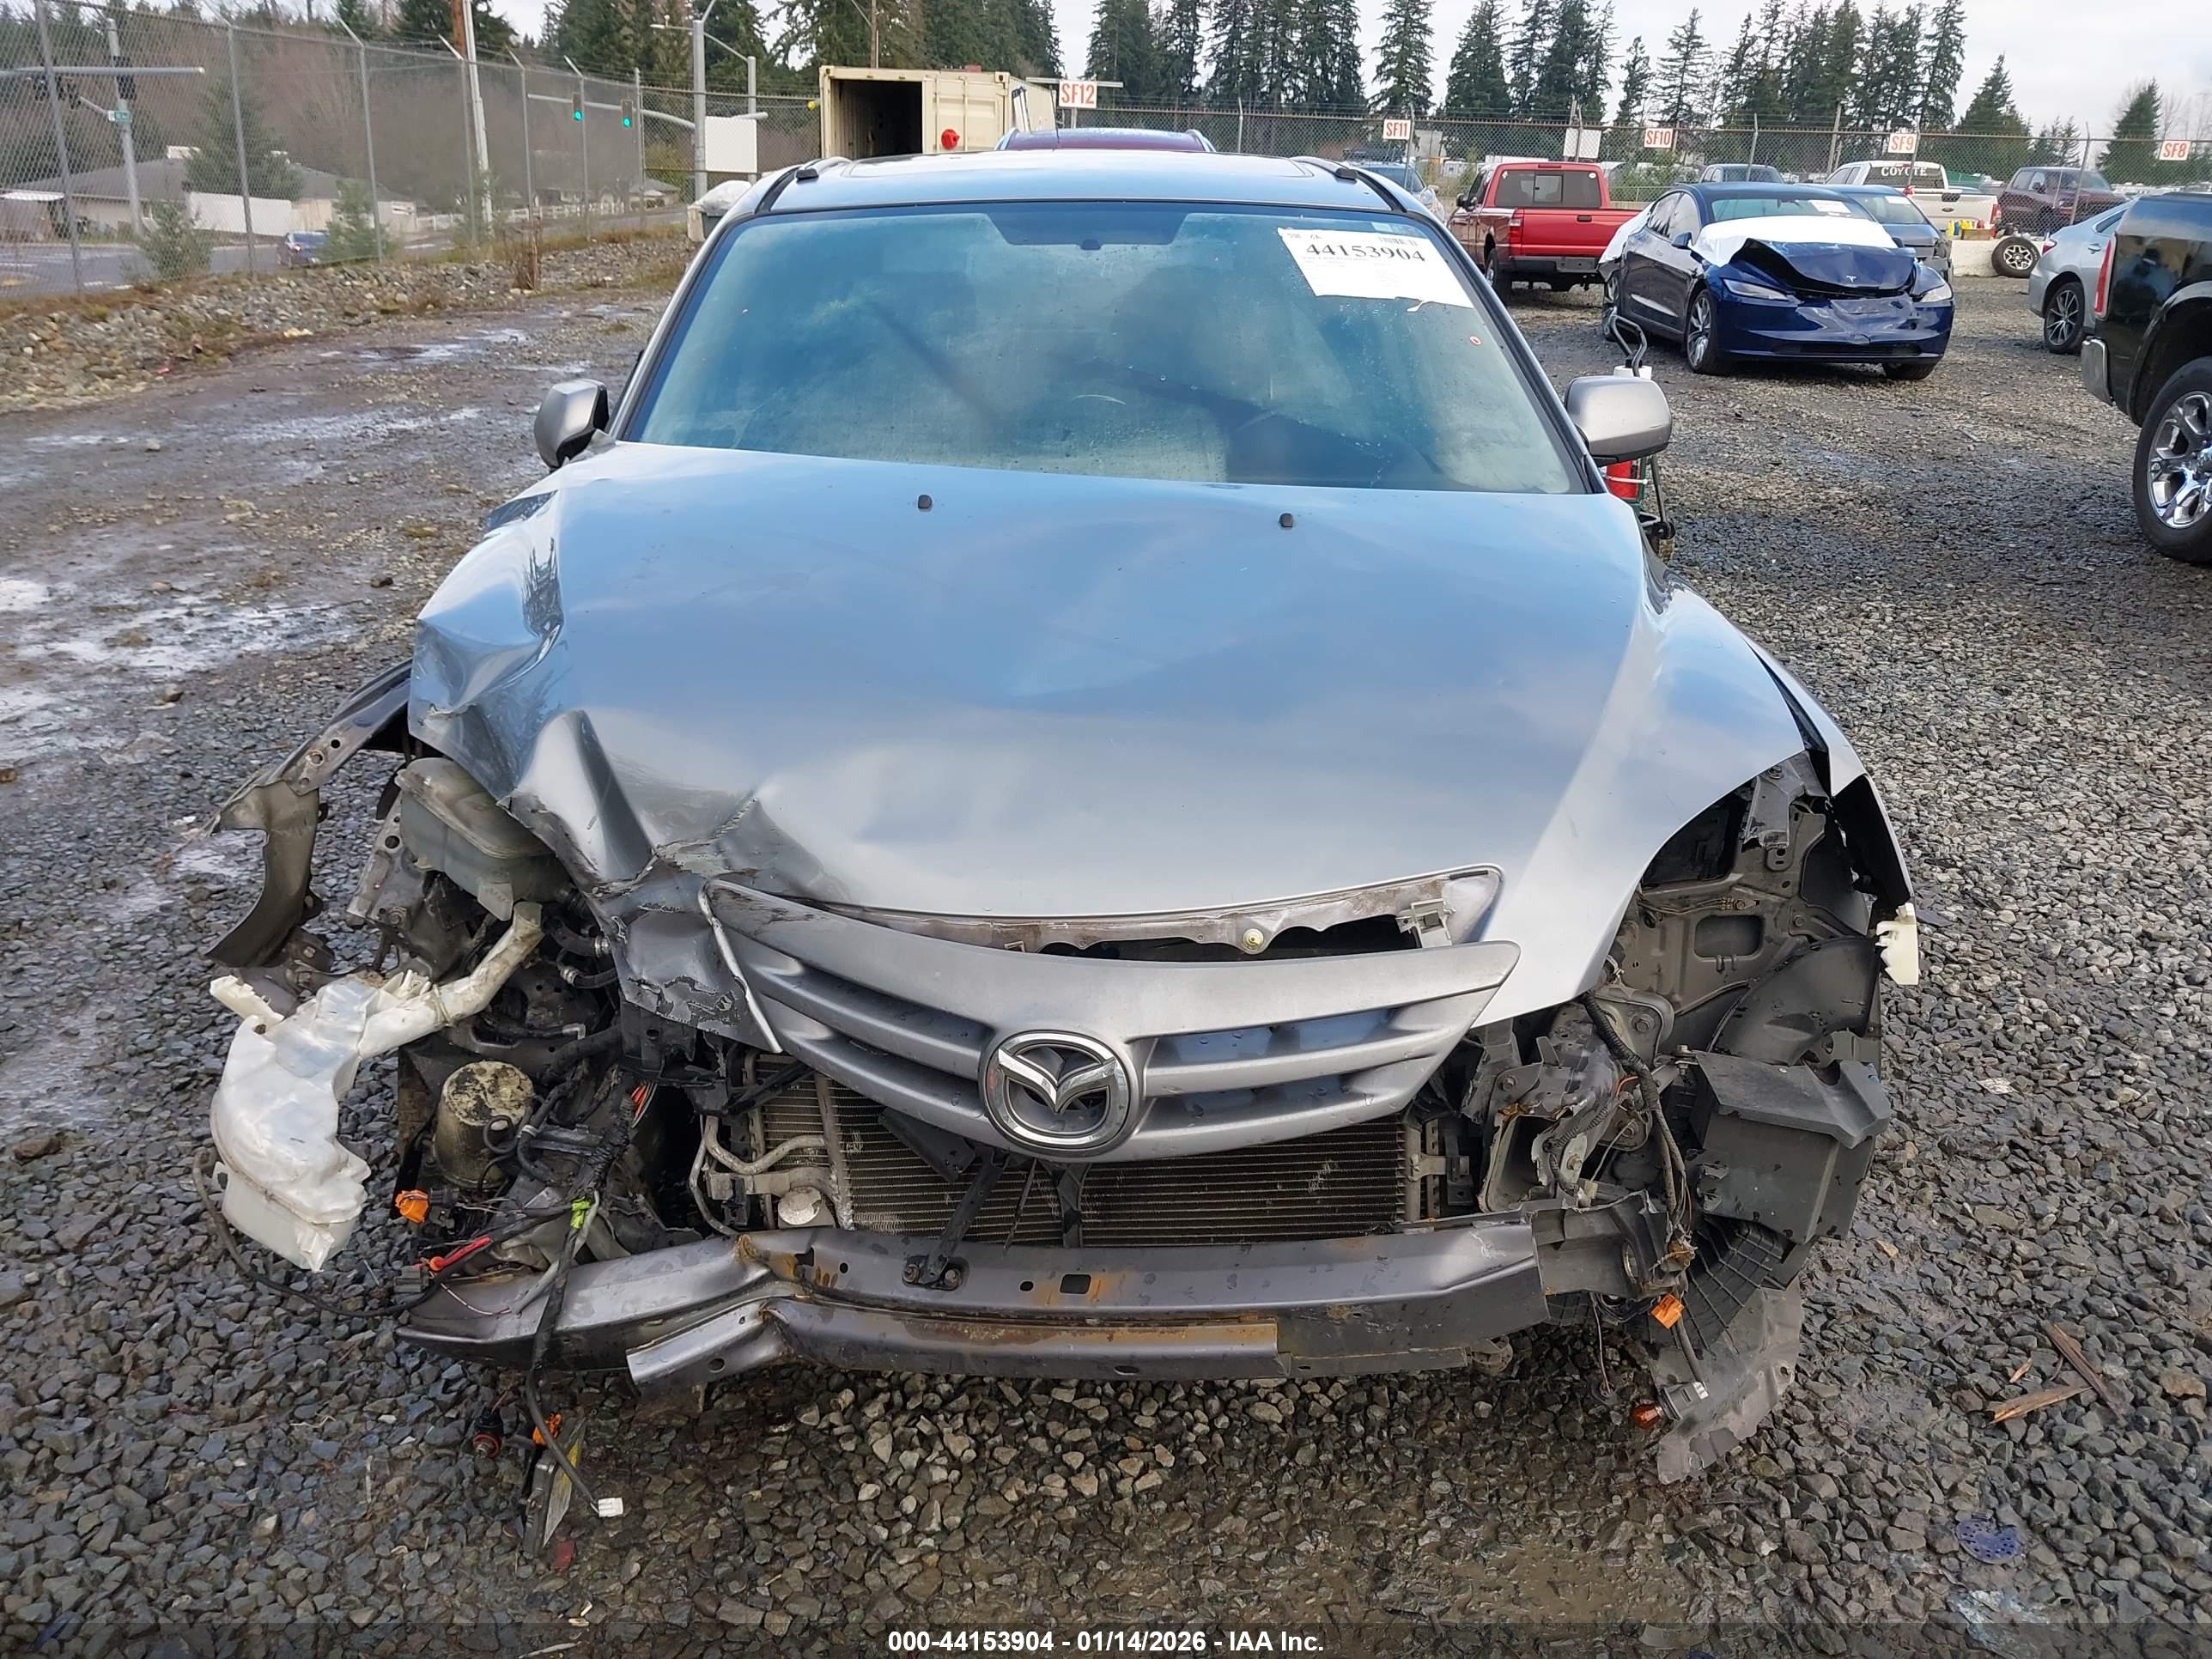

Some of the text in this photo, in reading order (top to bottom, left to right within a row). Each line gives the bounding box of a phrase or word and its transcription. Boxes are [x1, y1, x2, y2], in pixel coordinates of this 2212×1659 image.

[1061, 82, 1095, 104] SF12
[1386, 122, 1408, 137] SF11
[1646, 130, 1671, 145] SF10
[1891, 136, 1914, 151] SF9
[2163, 143, 2187, 158] SF8
[1306, 244, 1425, 262] 44153904
